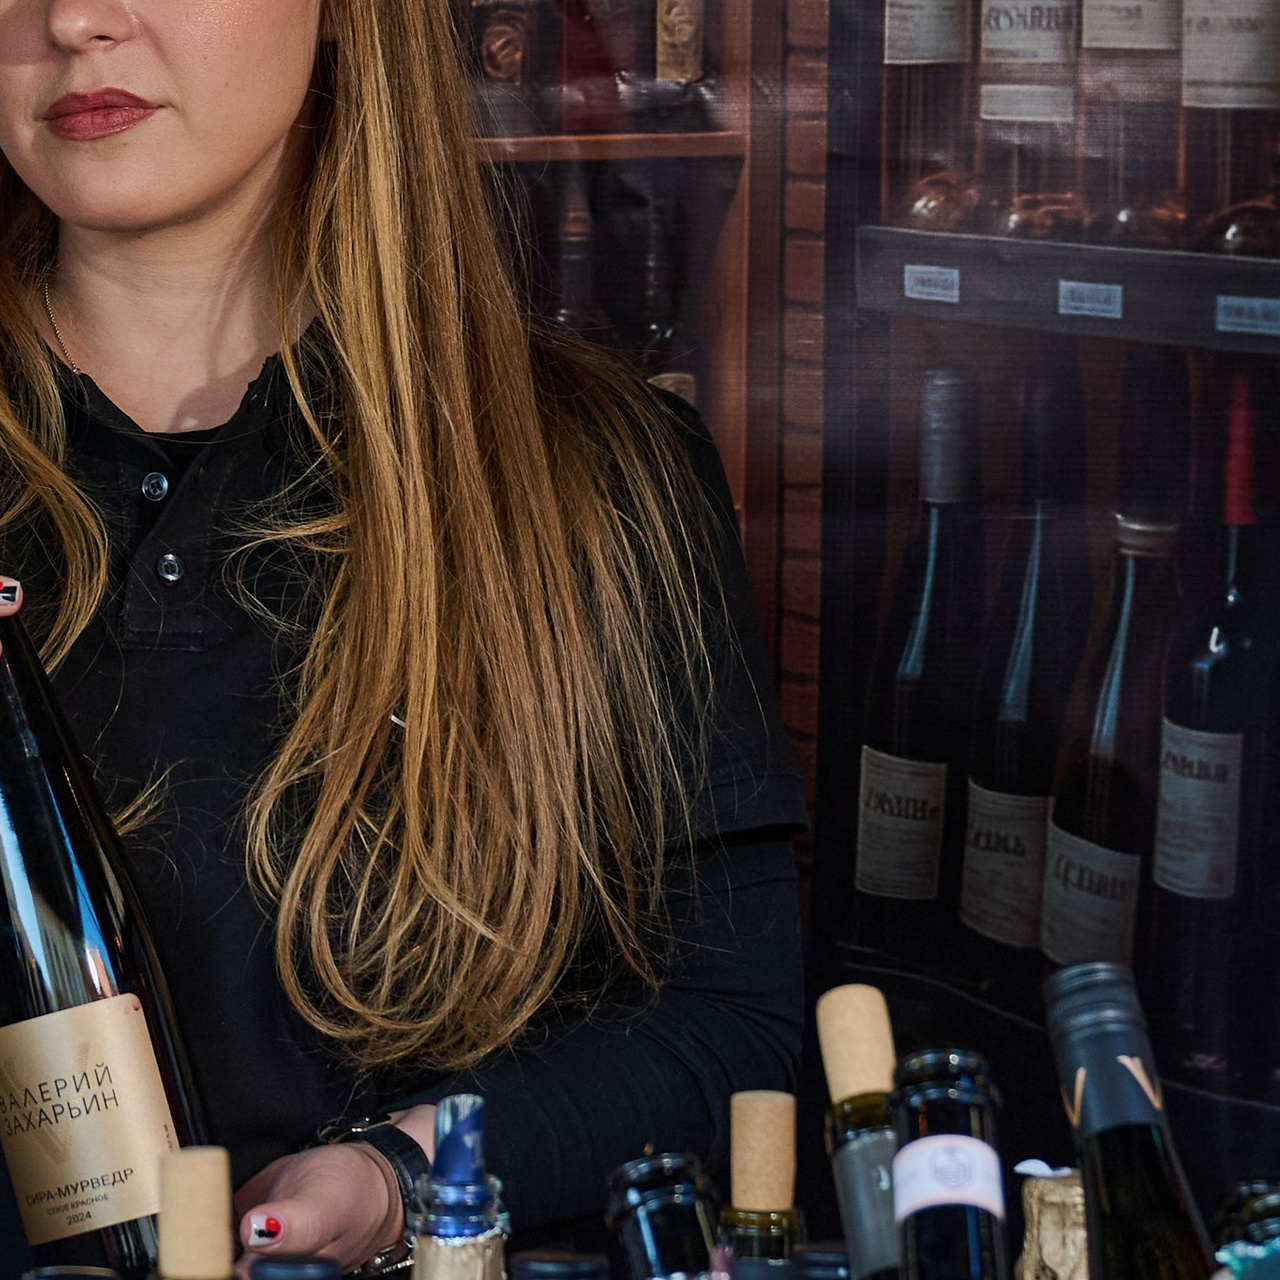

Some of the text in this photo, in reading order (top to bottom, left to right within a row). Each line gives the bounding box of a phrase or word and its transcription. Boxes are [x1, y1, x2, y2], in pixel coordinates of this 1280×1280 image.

[5, 1089, 119, 1137] ЗАХАРЬИН
[71, 1193, 110, 1210] КРАСНОЕ
[66, 1210, 92, 1226] 2024
